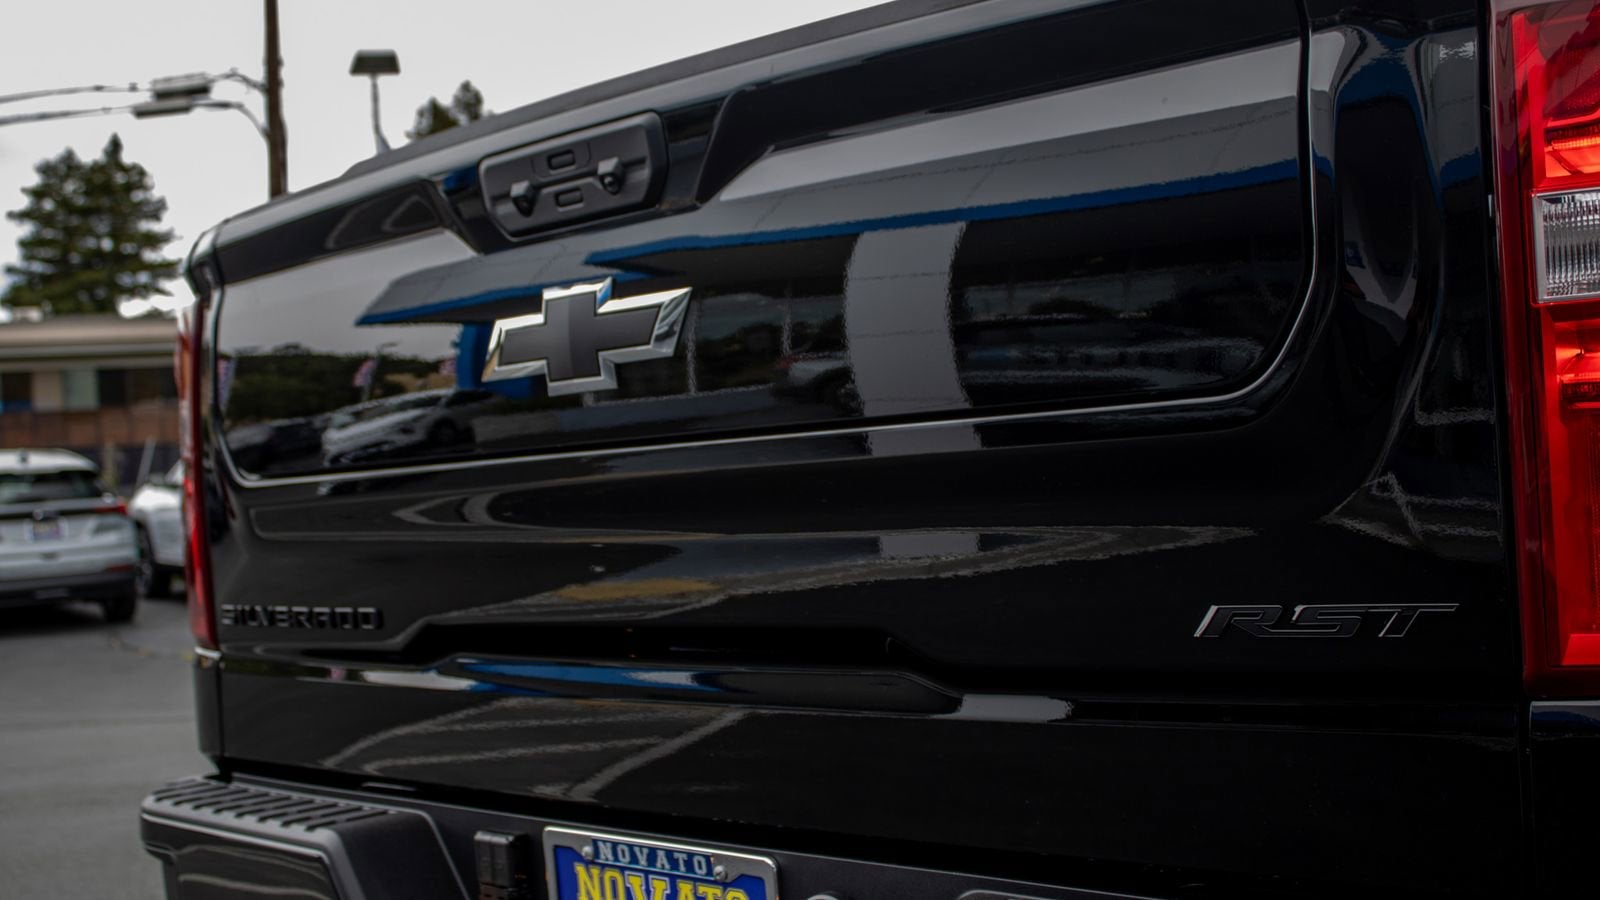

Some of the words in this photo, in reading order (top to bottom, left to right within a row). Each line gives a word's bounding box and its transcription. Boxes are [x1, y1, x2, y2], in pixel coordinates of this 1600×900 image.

[220, 604, 382, 629] SILVERADO
[1194, 603, 1460, 637] RST
[596, 840, 708, 877] NOVATO
